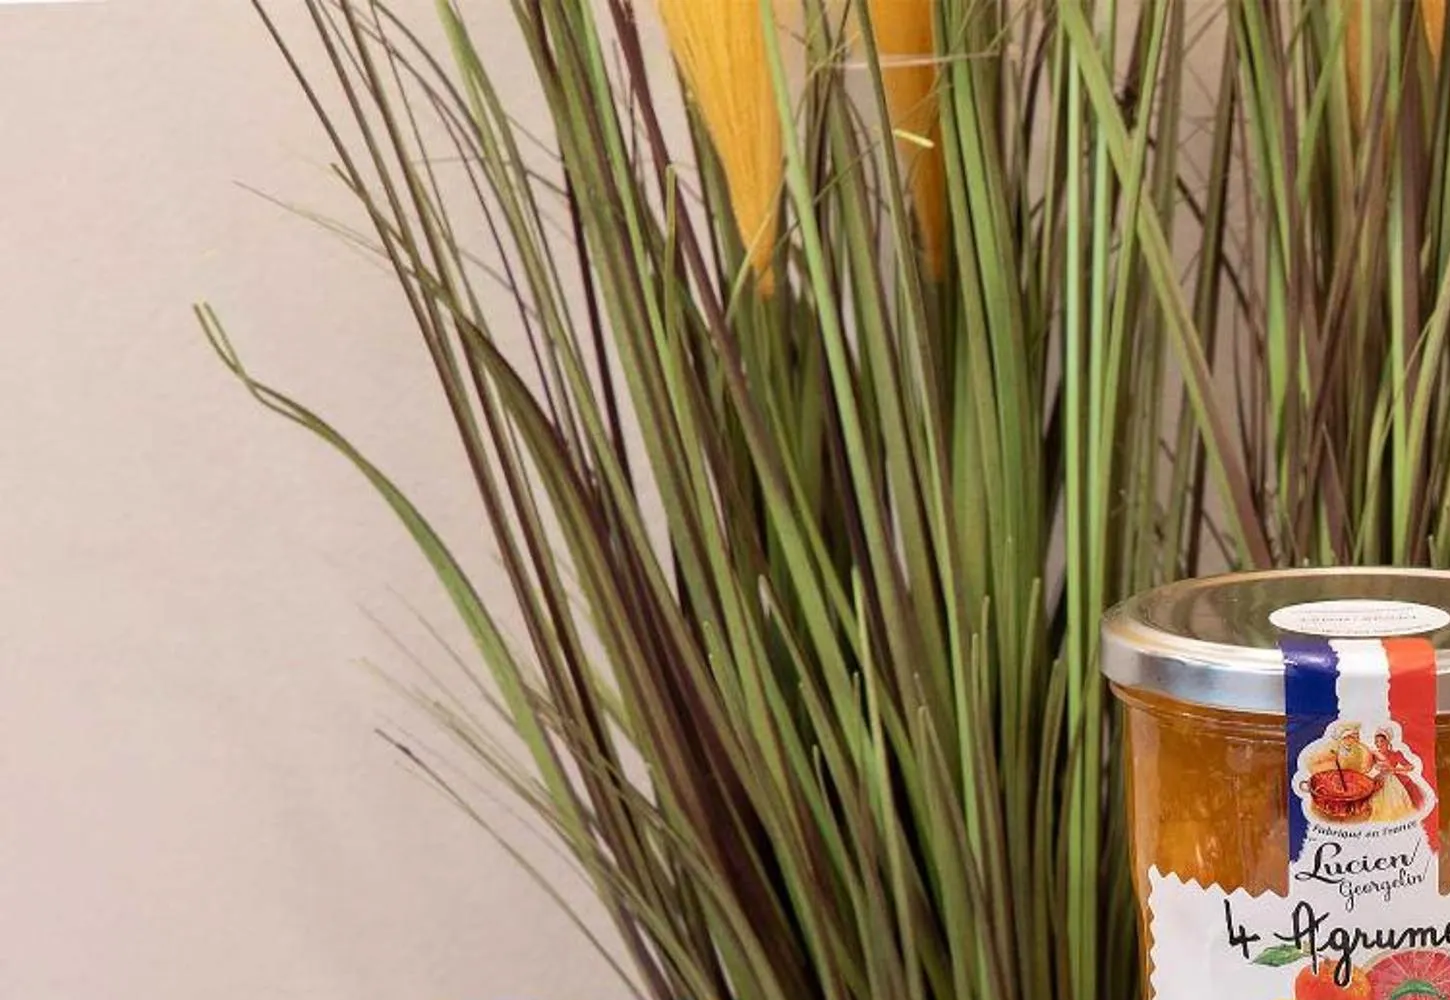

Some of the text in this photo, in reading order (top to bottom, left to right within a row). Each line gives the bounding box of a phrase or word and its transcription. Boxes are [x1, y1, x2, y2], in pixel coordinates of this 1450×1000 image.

[1295, 838, 1421, 884] Lucien
[1339, 860, 1430, 912] Georgelin
[1224, 899, 1260, 958] 4
